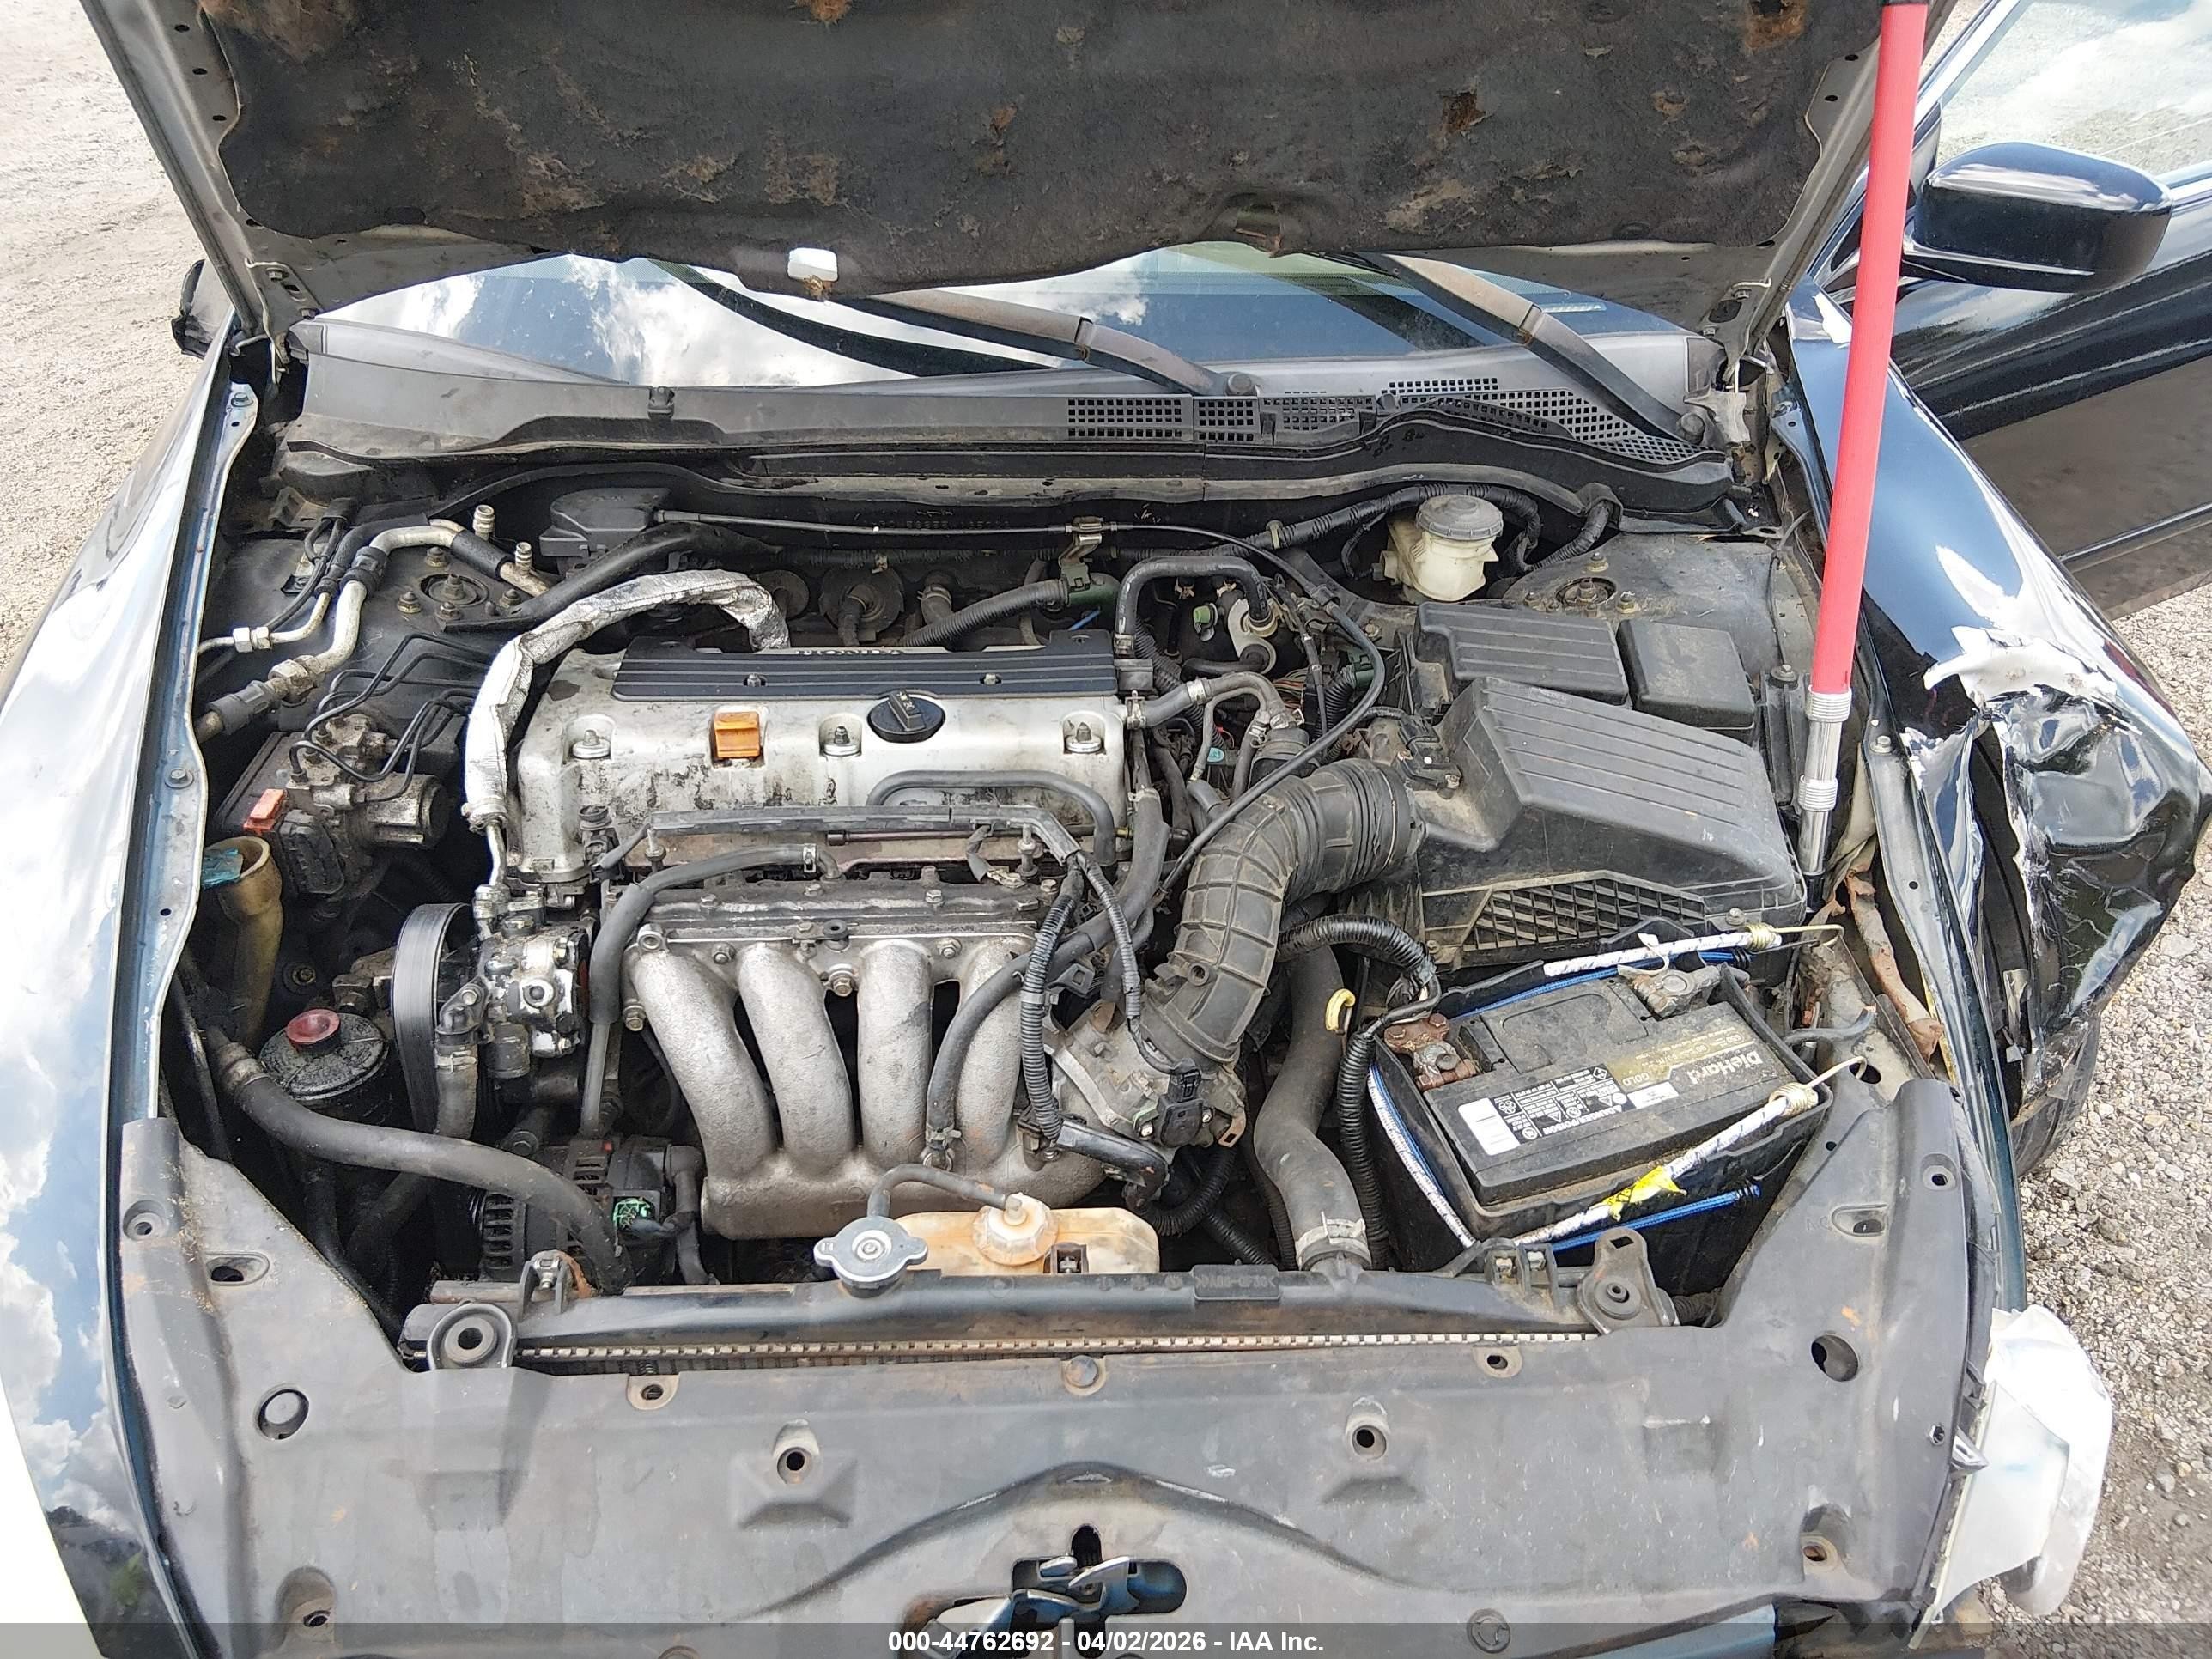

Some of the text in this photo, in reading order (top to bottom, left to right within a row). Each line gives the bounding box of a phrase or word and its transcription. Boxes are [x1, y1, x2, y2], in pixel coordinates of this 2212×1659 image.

[1621, 1072, 1650, 1085] GOLD
[1686, 1050, 1762, 1084] DieHard
[1542, 1106, 1615, 1134] DANGER/POISON
